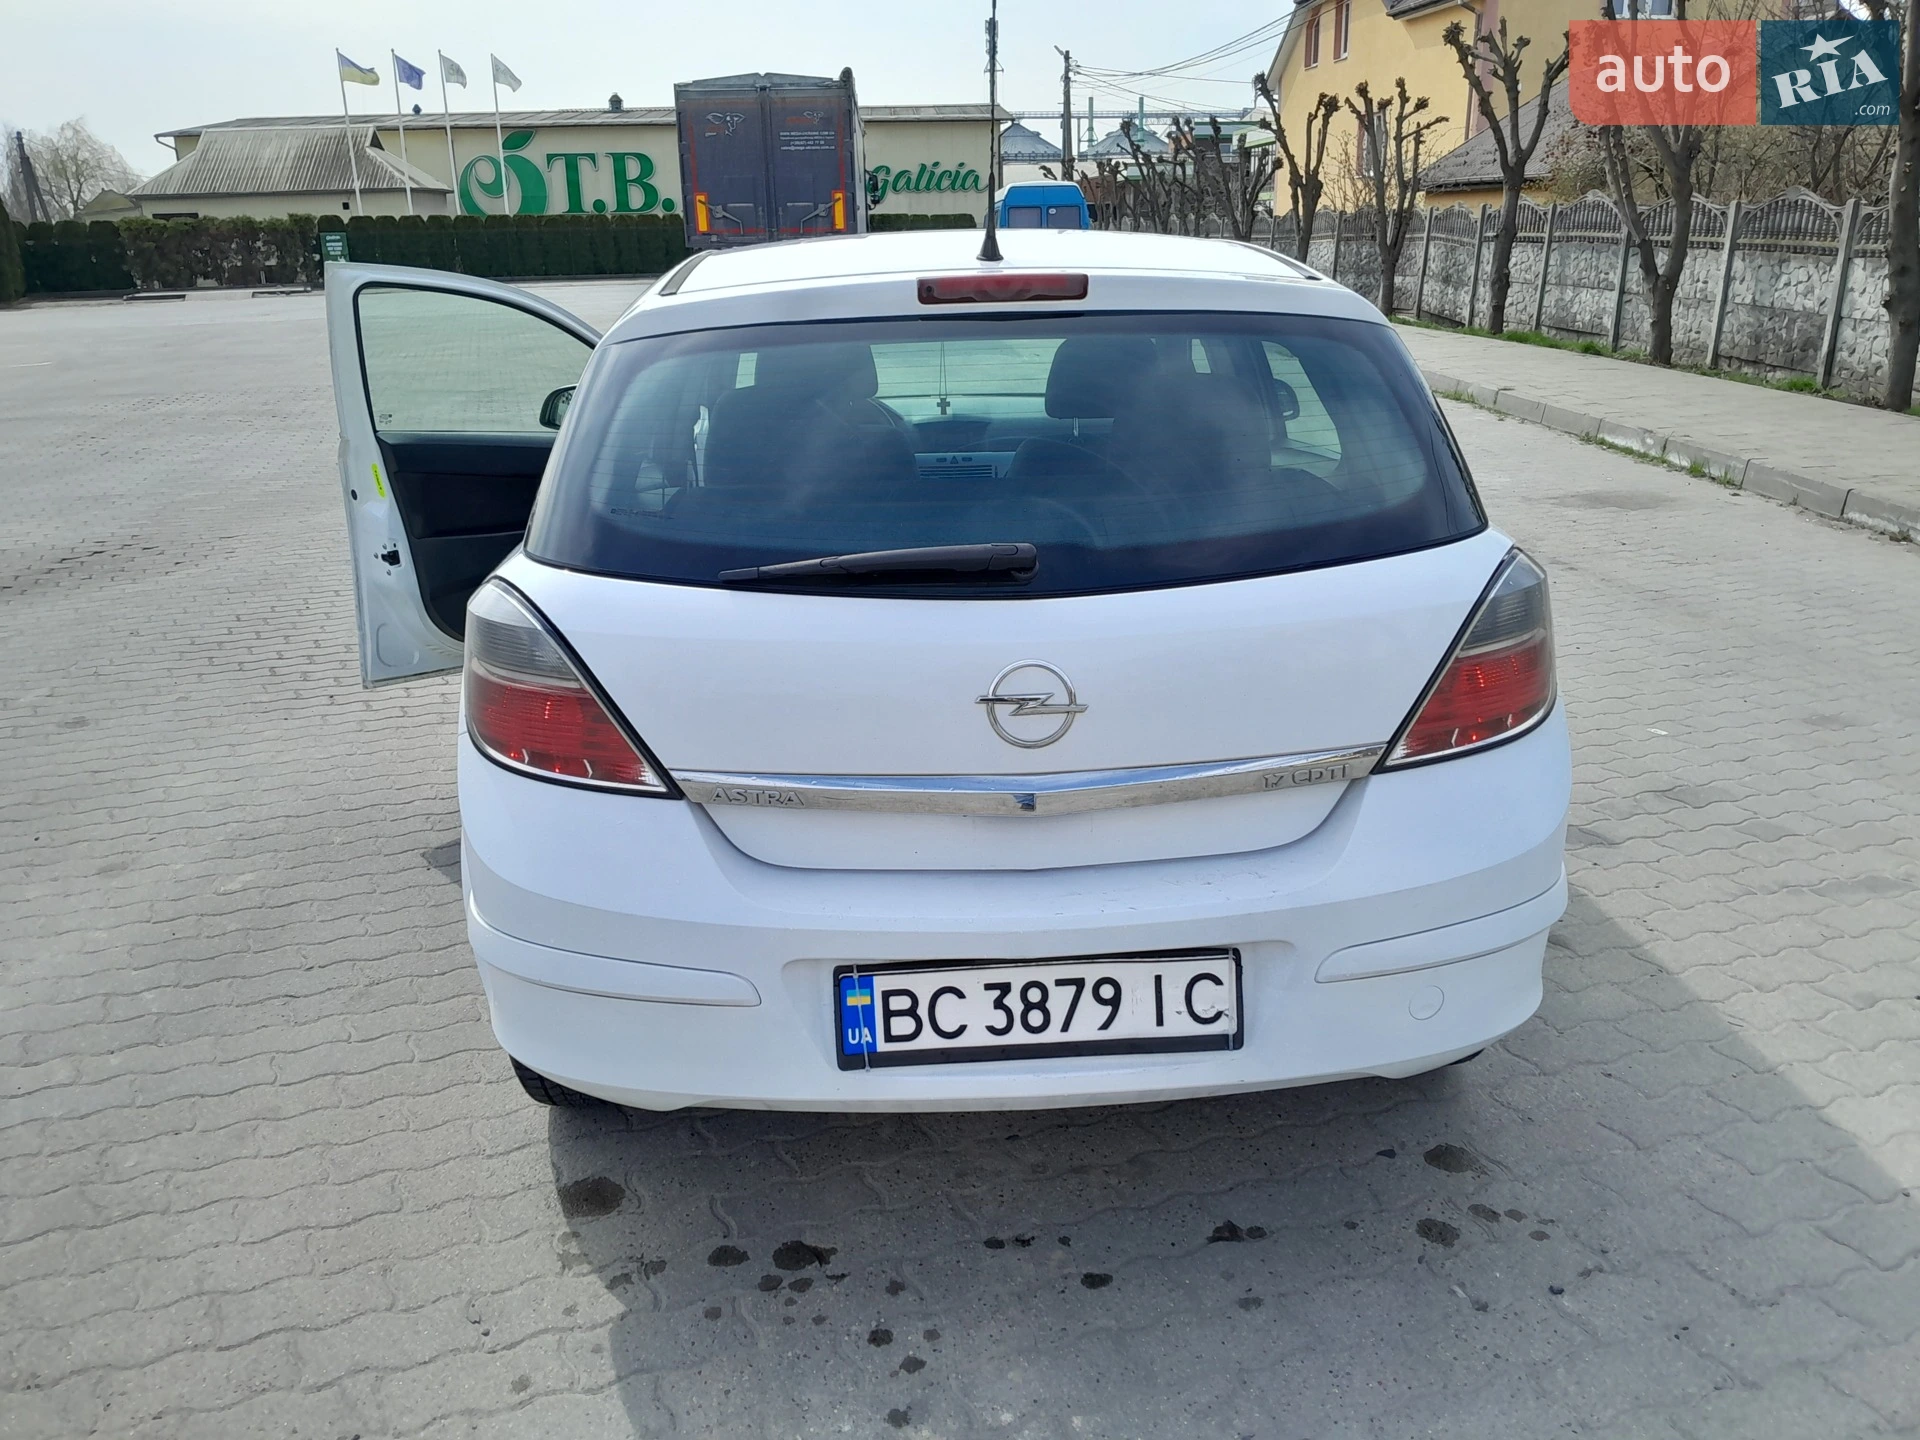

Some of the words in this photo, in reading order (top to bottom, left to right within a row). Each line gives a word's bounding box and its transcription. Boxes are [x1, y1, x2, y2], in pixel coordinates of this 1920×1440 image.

[866, 161, 989, 203] Galicia
[1292, 765, 1349, 784] CDTI
[710, 787, 805, 806] ASTRA
[881, 986, 968, 1043] BC
[984, 976, 1122, 1035] 3879
[1154, 973, 1225, 1027] IC
[848, 1026, 872, 1044] UA
